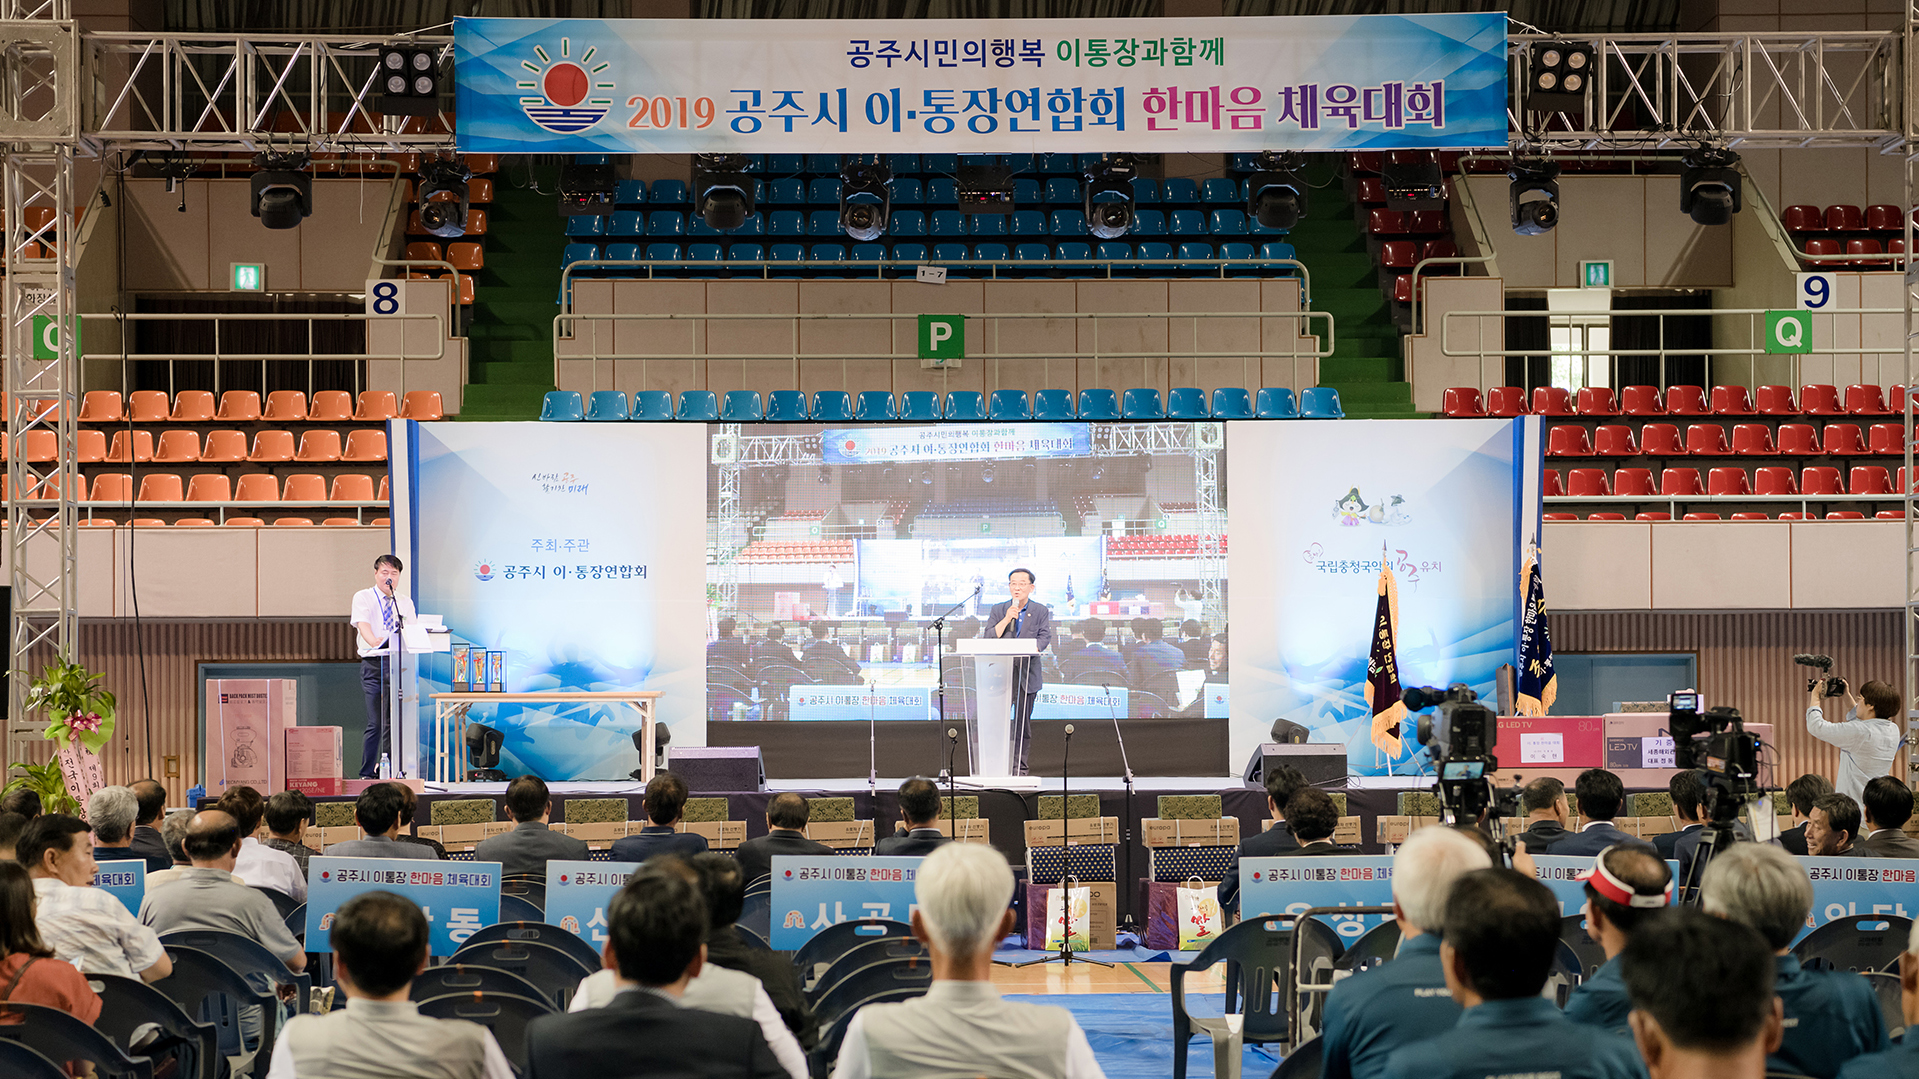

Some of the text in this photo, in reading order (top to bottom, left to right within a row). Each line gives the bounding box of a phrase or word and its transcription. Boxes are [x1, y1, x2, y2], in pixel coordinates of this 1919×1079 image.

[846, 37, 1225, 68] 공주시민의행복 이통장과함께
[627, 82, 1444, 134] 2019 공주시 이·통장연합회 한마음 체육대회
[372, 282, 400, 315] 8
[1803, 276, 1830, 309] 9
[930, 322, 953, 351] P
[1775, 317, 1803, 348] Q
[889, 444, 920, 456] 공주시
[994, 439, 1025, 452] 한마음
[1029, 437, 1074, 451] 체육대회
[530, 538, 590, 553] 주최·주관
[503, 564, 546, 580] 공주시
[1420, 561, 1442, 573] 유치
[809, 695, 922, 706] 공주시 이통장 한마음 체육대회
[1060, 694, 1085, 706] 한마음
[1087, 696, 1121, 707] 체육대회
[1609, 743, 1638, 751] LED TV
[336, 869, 492, 887] 공주시 이통장 한마음 체육대회
[575, 872, 608, 885] 공주시
[799, 867, 831, 880] 공주시
[834, 867, 867, 881] 이통장
[870, 868, 902, 881] 한마음
[1268, 868, 1301, 882] 공주시
[1303, 868, 1337, 881] 이통장
[1340, 867, 1373, 881] 한마음
[1810, 867, 1916, 883] 공주시 이통장 한마음
